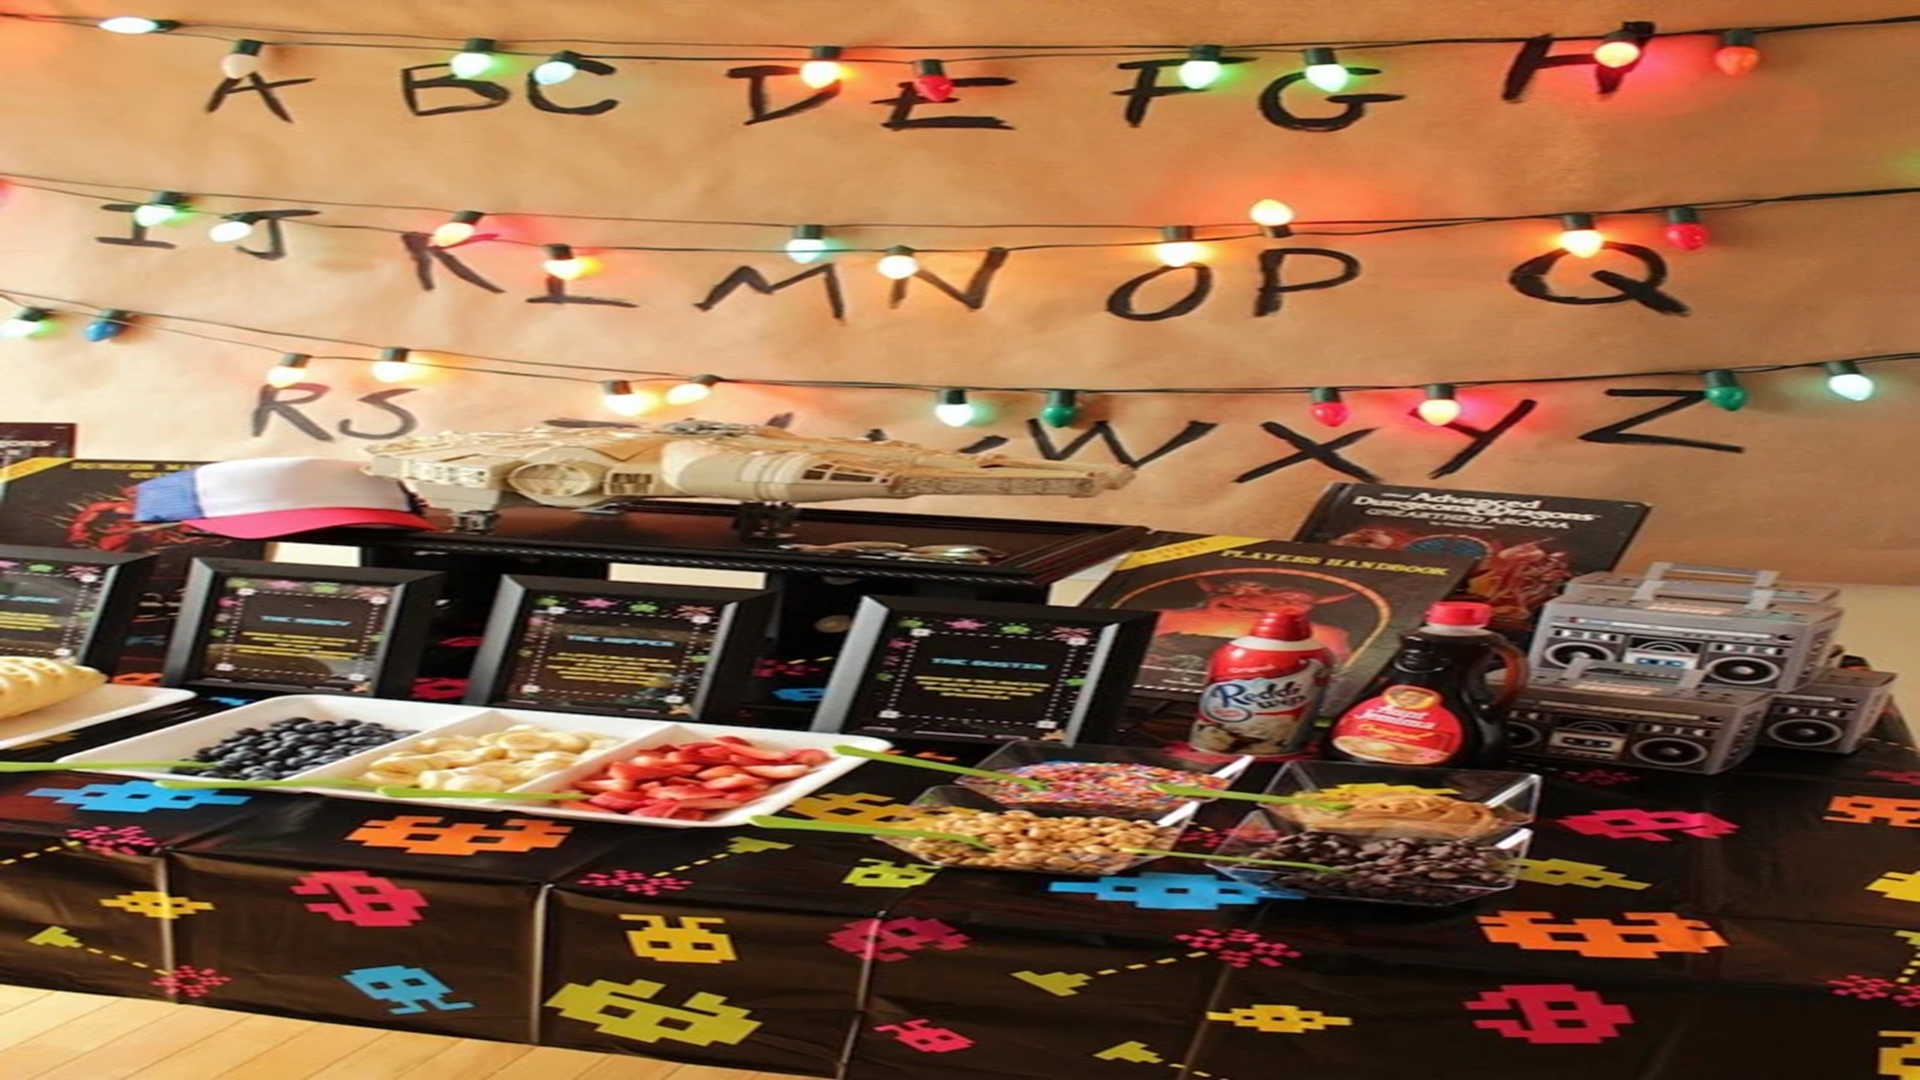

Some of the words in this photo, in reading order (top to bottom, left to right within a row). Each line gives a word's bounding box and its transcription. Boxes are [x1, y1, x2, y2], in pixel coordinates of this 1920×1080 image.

[206, 70, 316, 123] A
[402, 62, 511, 116] B
[527, 57, 618, 115] C
[727, 65, 843, 125] D
[871, 77, 1017, 131] E
[1112, 56, 1259, 127] F
[1258, 67, 1405, 132] G
[1502, 21, 1654, 102] H
[222, 209, 320, 260] J
[401, 232, 506, 292] K
[692, 264, 845, 324] M
[892, 247, 1010, 310] N
[1105, 260, 1212, 322] O
[1253, 247, 1362, 318] P
[1508, 240, 1690, 317] Q
[252, 383, 335, 442] R
[338, 388, 418, 440] S
[1027, 418, 1218, 469] W
[1233, 421, 1384, 483] X
[1408, 399, 1537, 479] Y
[1578, 388, 1744, 453] Z
[1353, 496, 1473, 514] Dungeons
[1496, 503, 1596, 522] Dragons
[1411, 492, 1541, 510] Advanced
[1487, 517, 1570, 530] ARCANA
[1219, 549, 1321, 565] PLAYERS
[1326, 558, 1451, 576] HANDBOOK
